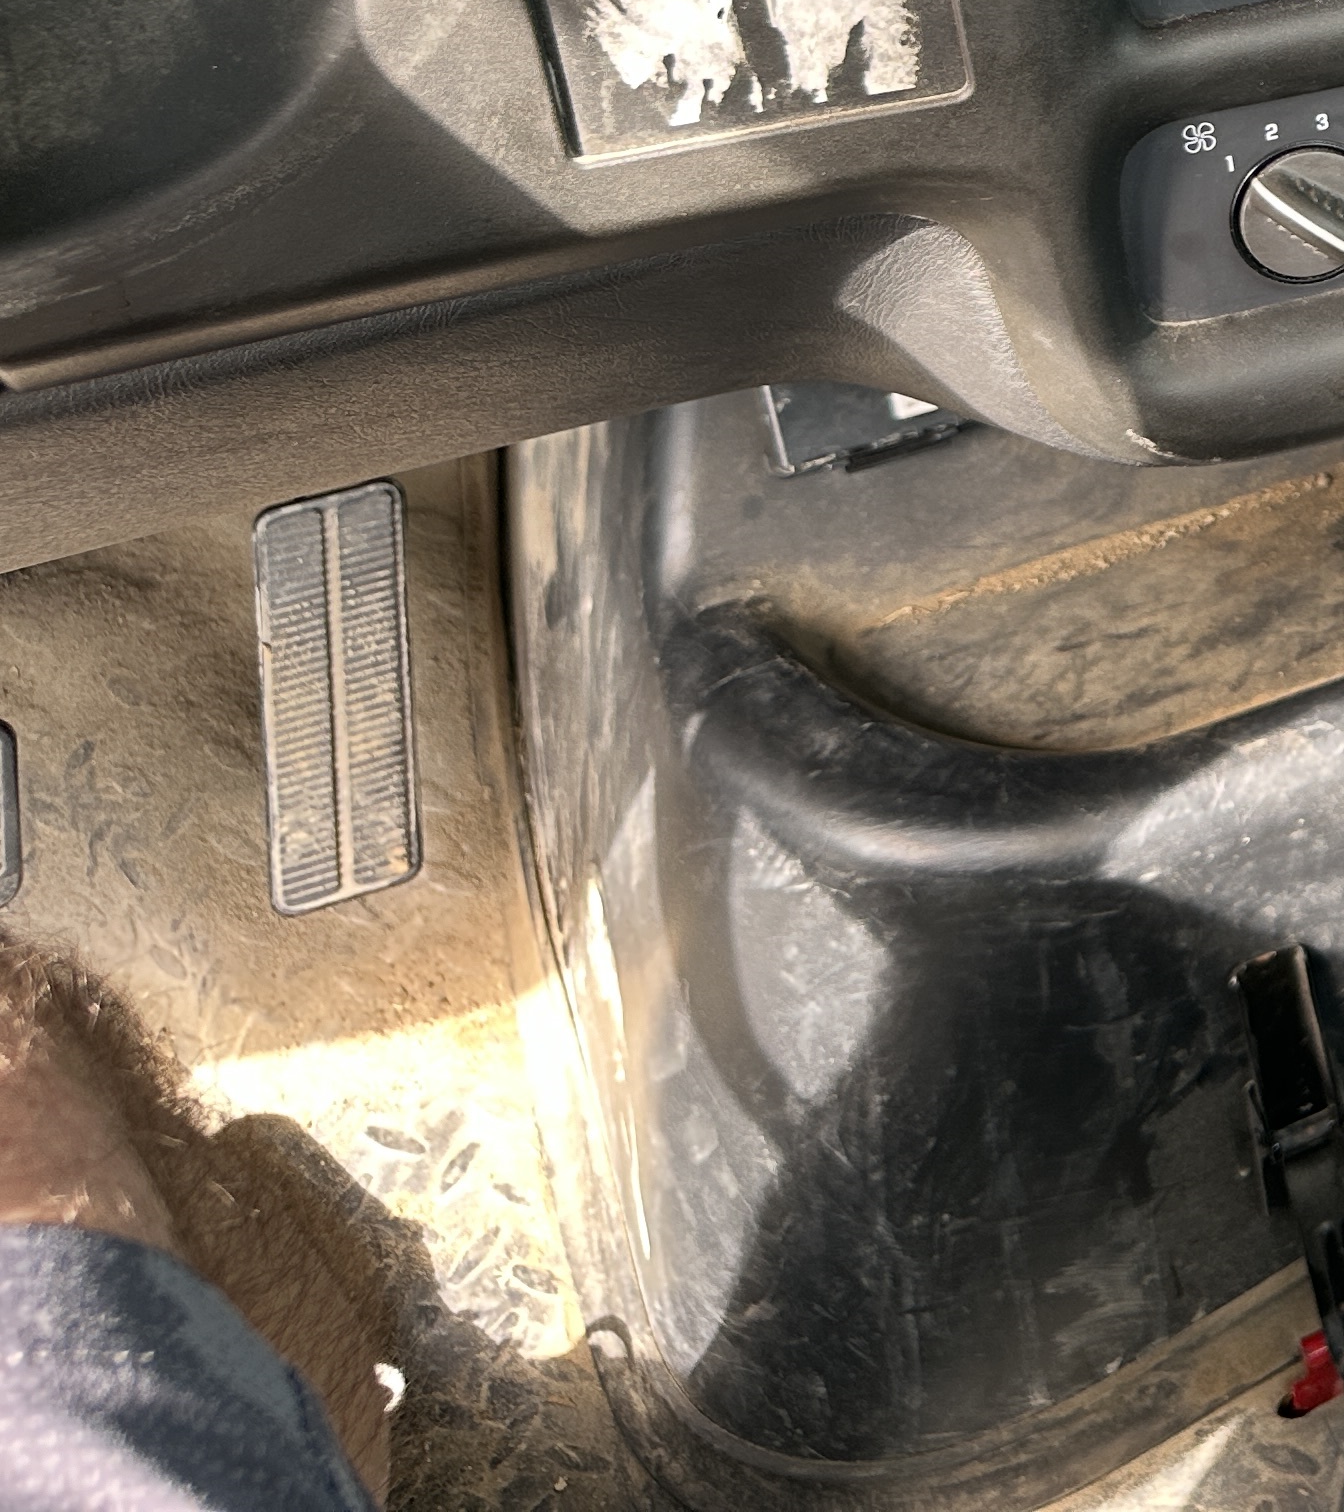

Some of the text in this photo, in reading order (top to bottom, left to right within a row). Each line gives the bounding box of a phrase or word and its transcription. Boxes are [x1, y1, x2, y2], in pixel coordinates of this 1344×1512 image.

[1315, 113, 1330, 131] 3
[1264, 123, 1279, 141] 2
[1224, 155, 1235, 172] 1
